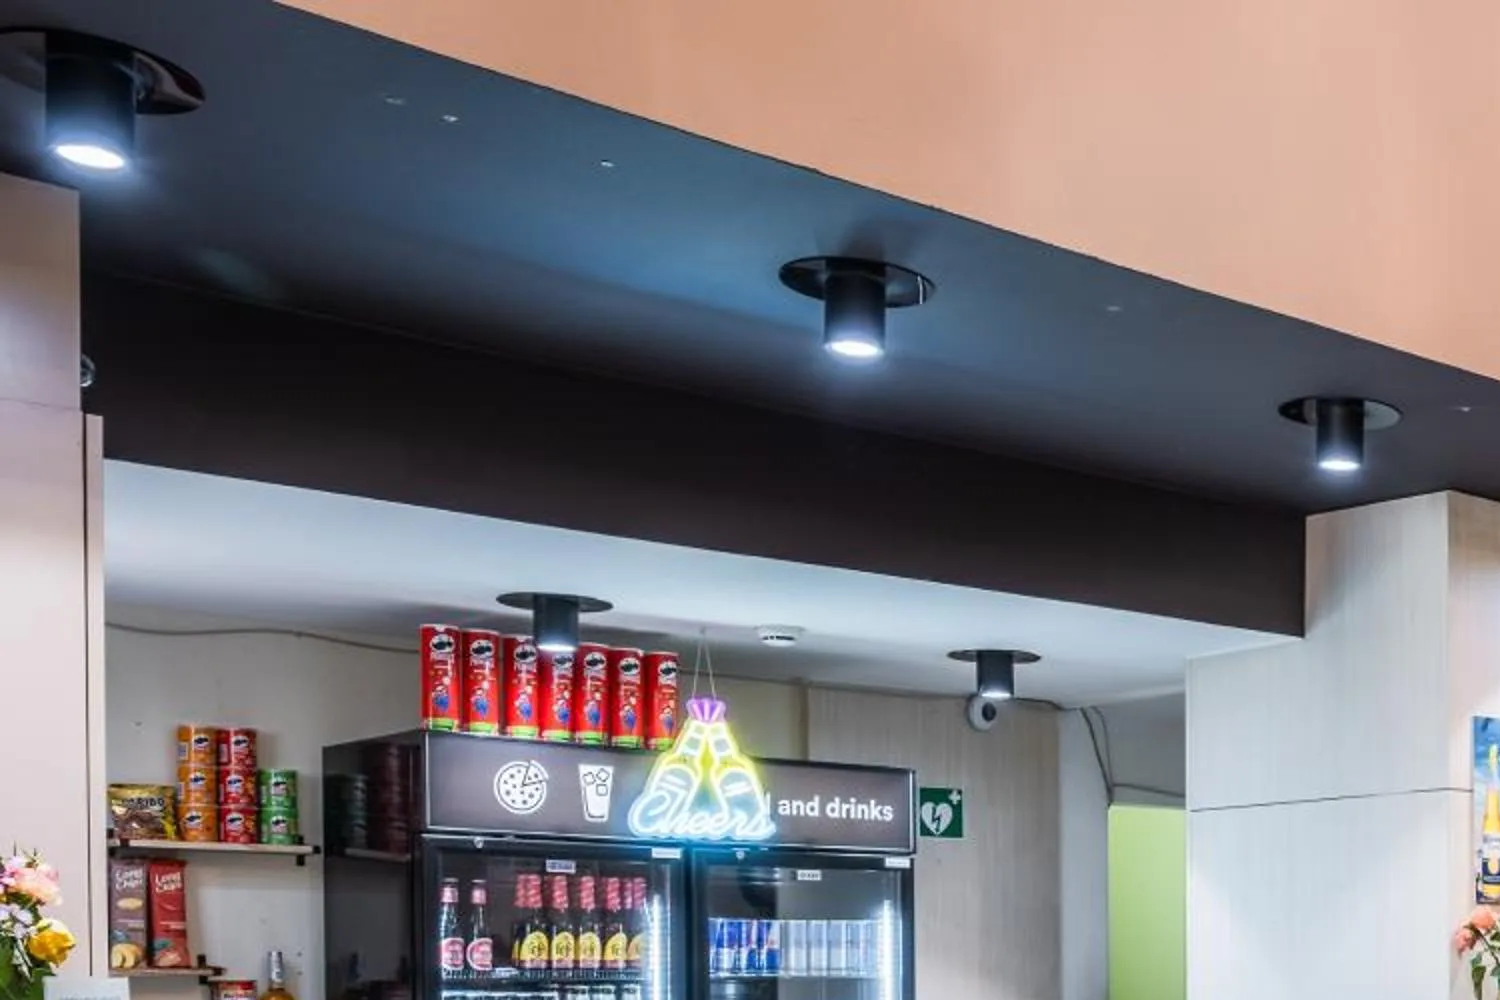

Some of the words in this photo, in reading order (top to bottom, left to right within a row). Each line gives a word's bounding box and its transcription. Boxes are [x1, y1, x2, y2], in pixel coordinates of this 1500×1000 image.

[628, 786, 777, 840] Cheers
[778, 795, 820, 817] and
[825, 794, 894, 822] drinks
